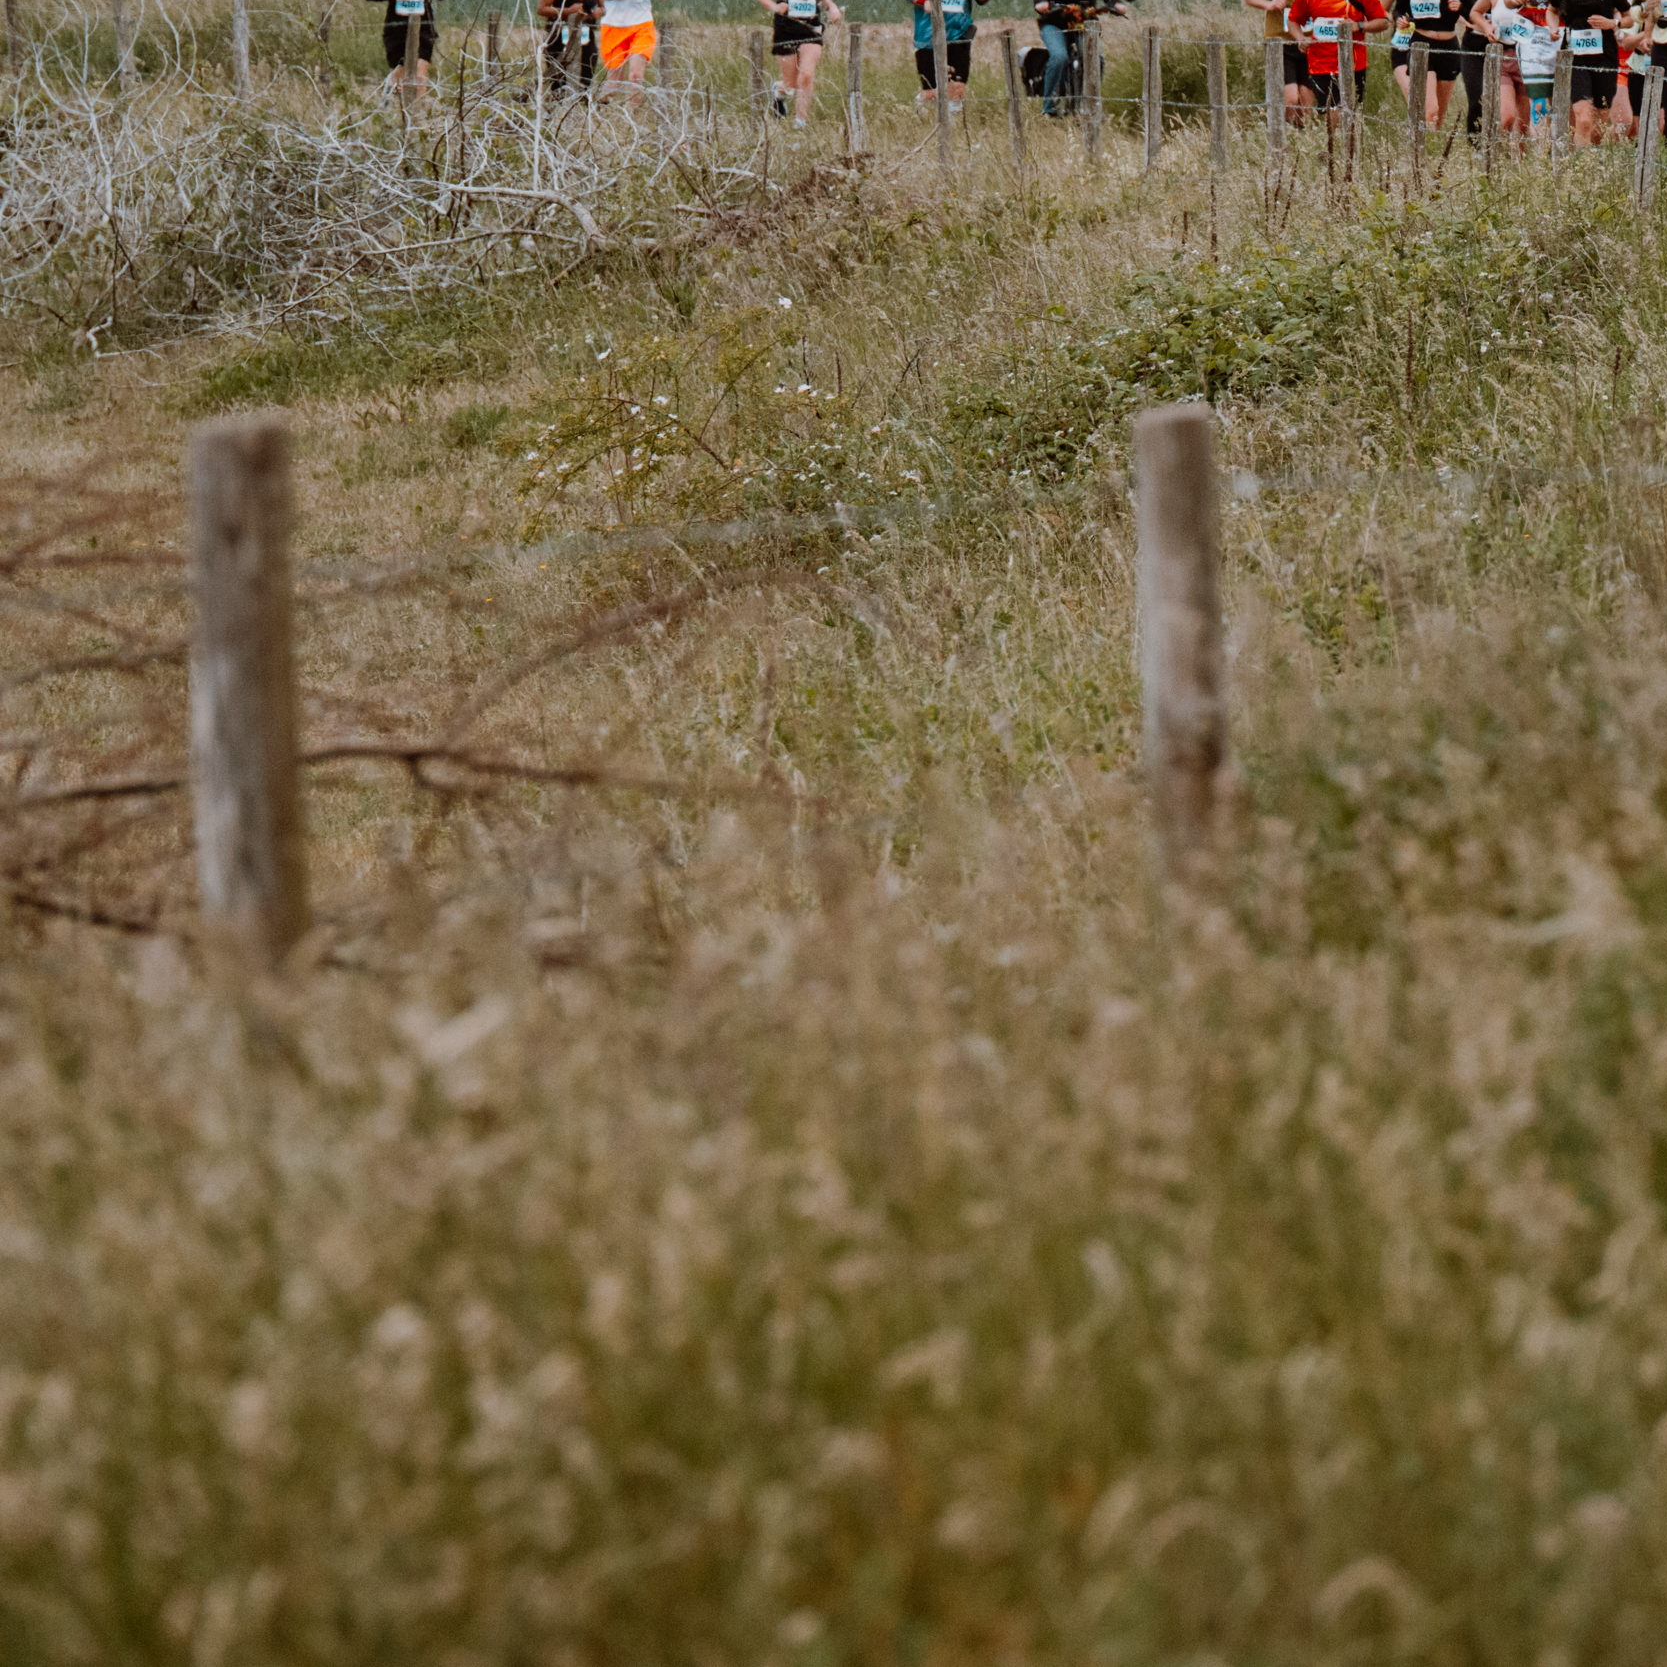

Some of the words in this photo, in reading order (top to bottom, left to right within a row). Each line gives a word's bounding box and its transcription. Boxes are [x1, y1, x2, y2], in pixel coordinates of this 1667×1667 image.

[794, 2, 812, 11] 4202
[1414, 2, 1435, 12] 4247
[1575, 38, 1597, 47] 4766
